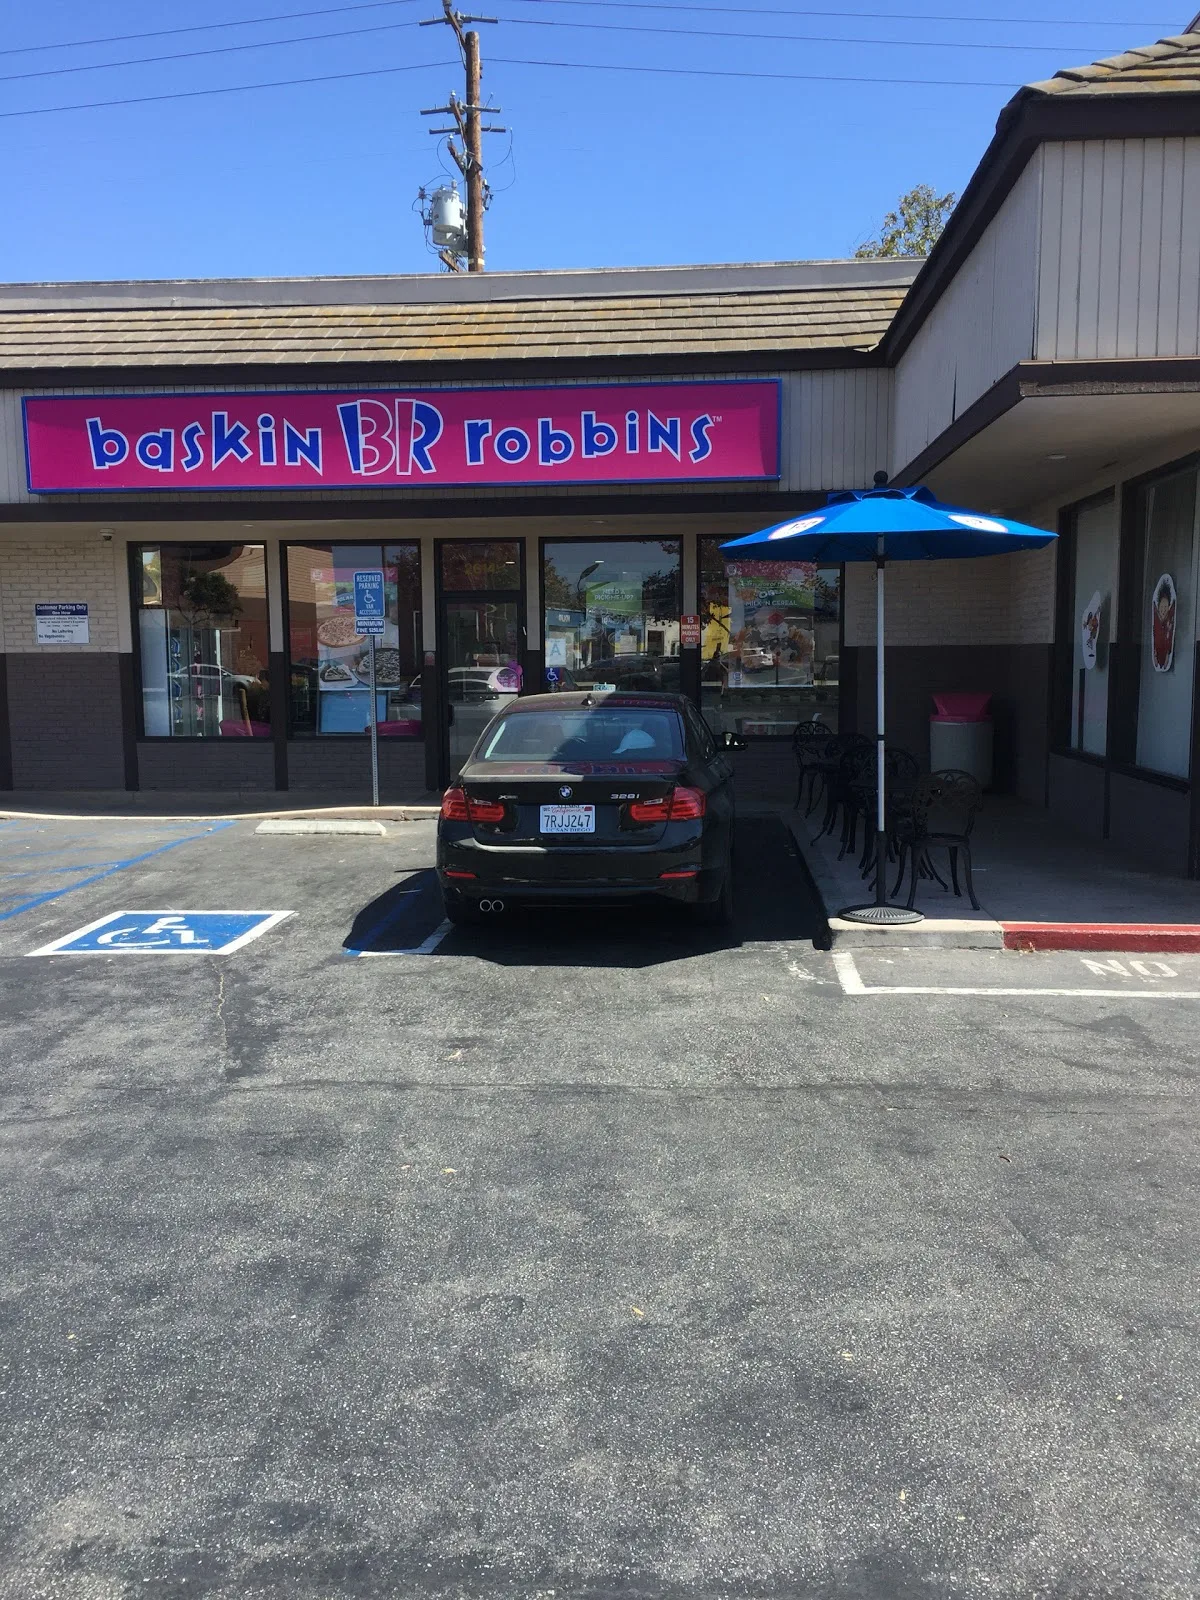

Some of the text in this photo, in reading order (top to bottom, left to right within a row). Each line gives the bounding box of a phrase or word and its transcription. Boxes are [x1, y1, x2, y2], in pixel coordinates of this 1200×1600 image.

[86, 410, 323, 476] baskin
[336, 398, 444, 477] BR
[464, 409, 715, 466] robbins
[356, 574, 381, 582] RESERVED
[550, 643, 561, 657] A
[544, 814, 591, 828] 7RJJ247
[1080, 959, 1179, 978] NO
